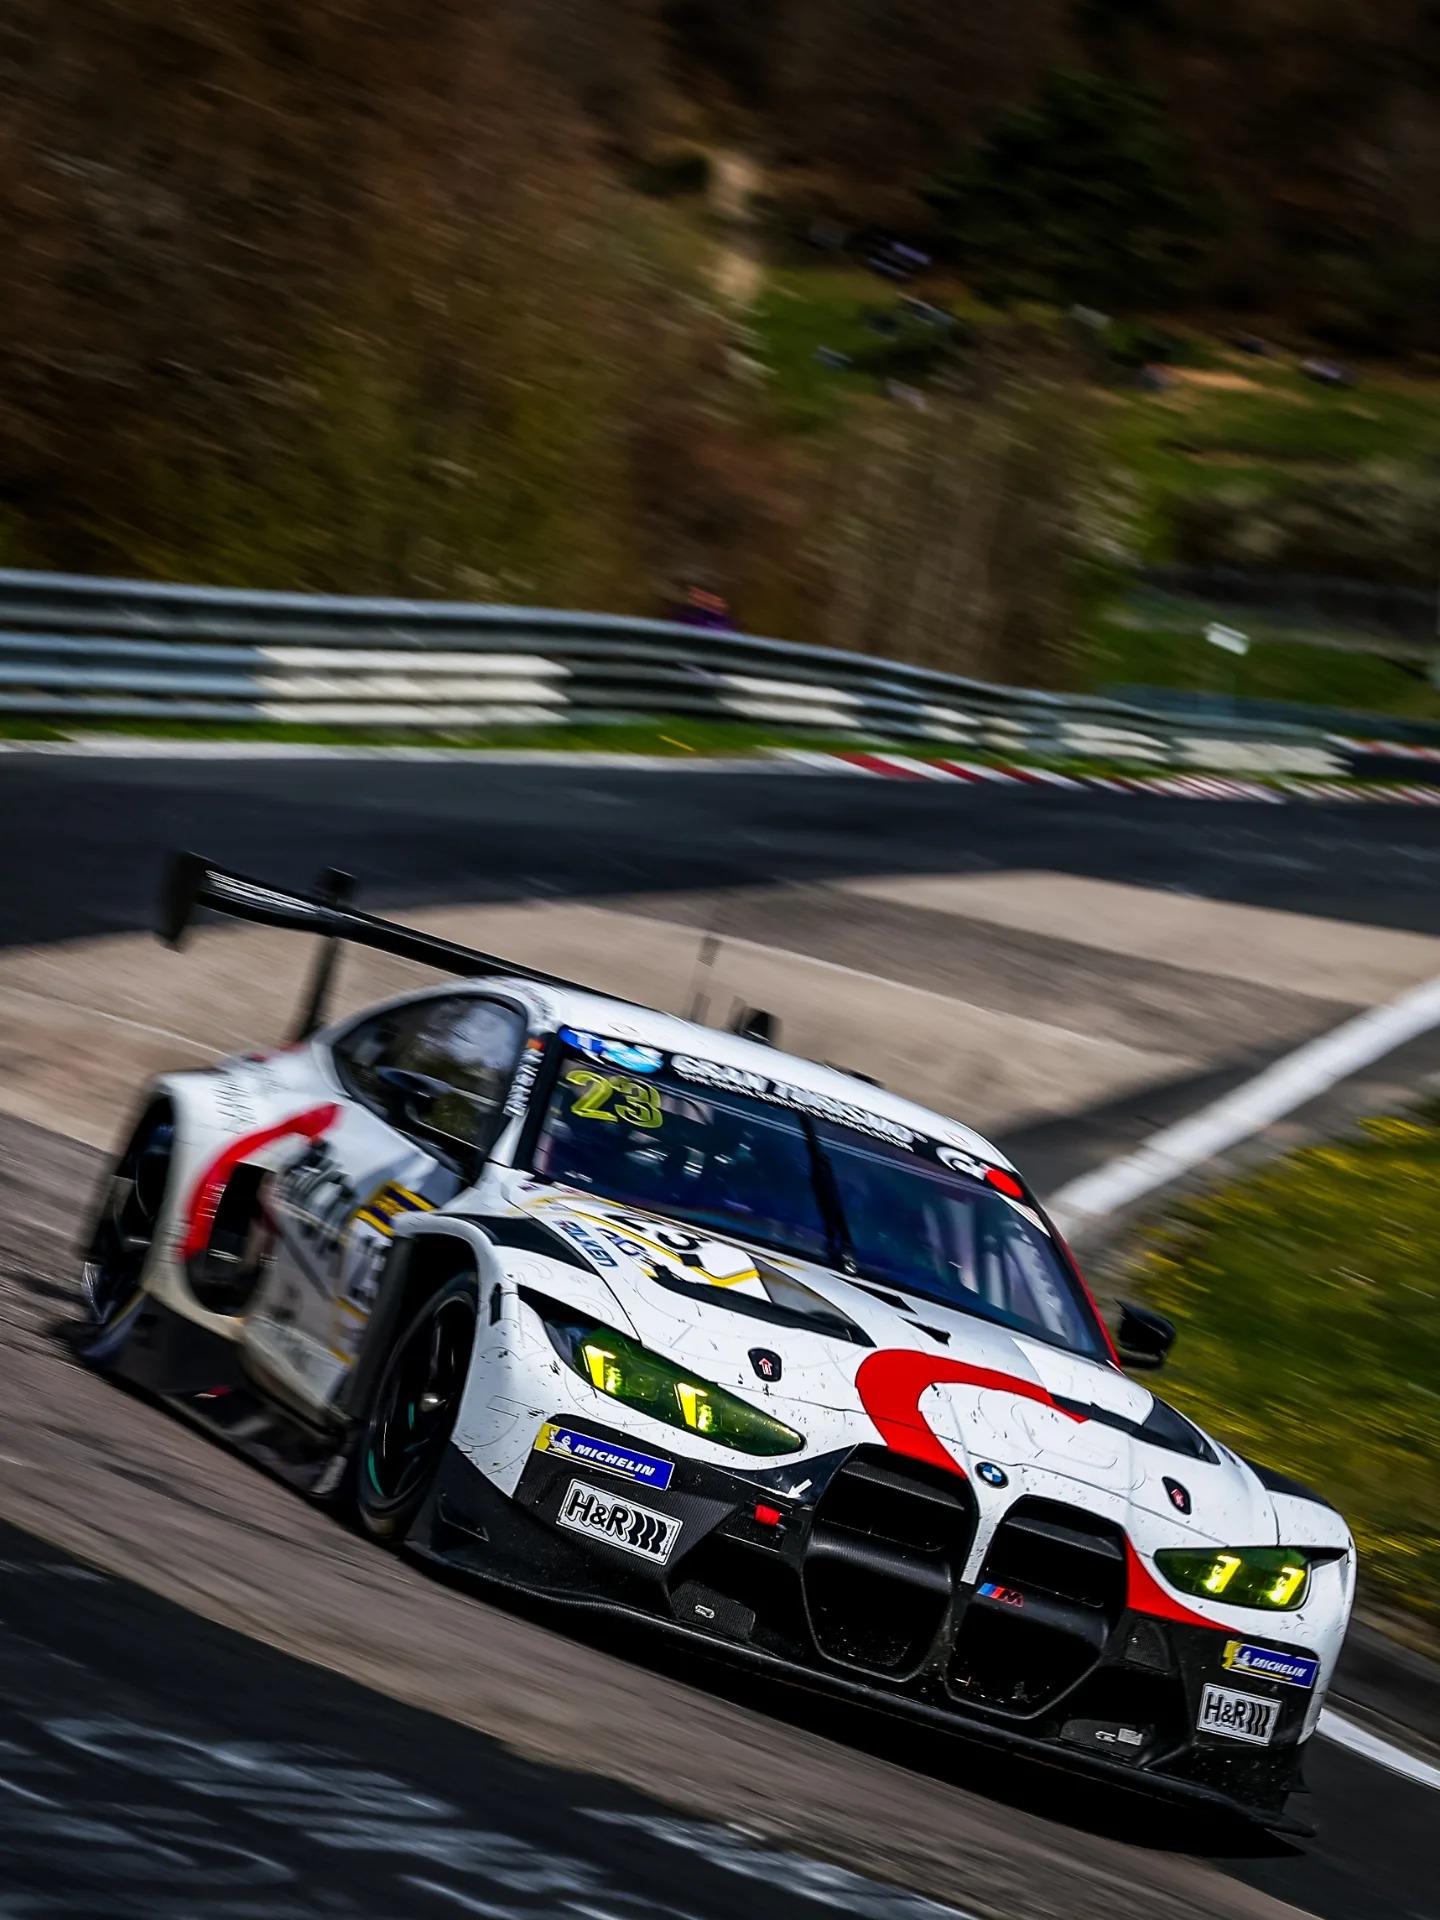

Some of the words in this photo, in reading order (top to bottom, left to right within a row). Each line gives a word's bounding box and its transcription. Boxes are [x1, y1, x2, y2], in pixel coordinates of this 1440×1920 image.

[565, 1070, 663, 1128] 23
[574, 1443, 656, 1477] MICHELIN
[566, 1489, 633, 1540] H&R
[1251, 1657, 1307, 1677] MICHELIN
[1204, 1692, 1249, 1731] H&R
